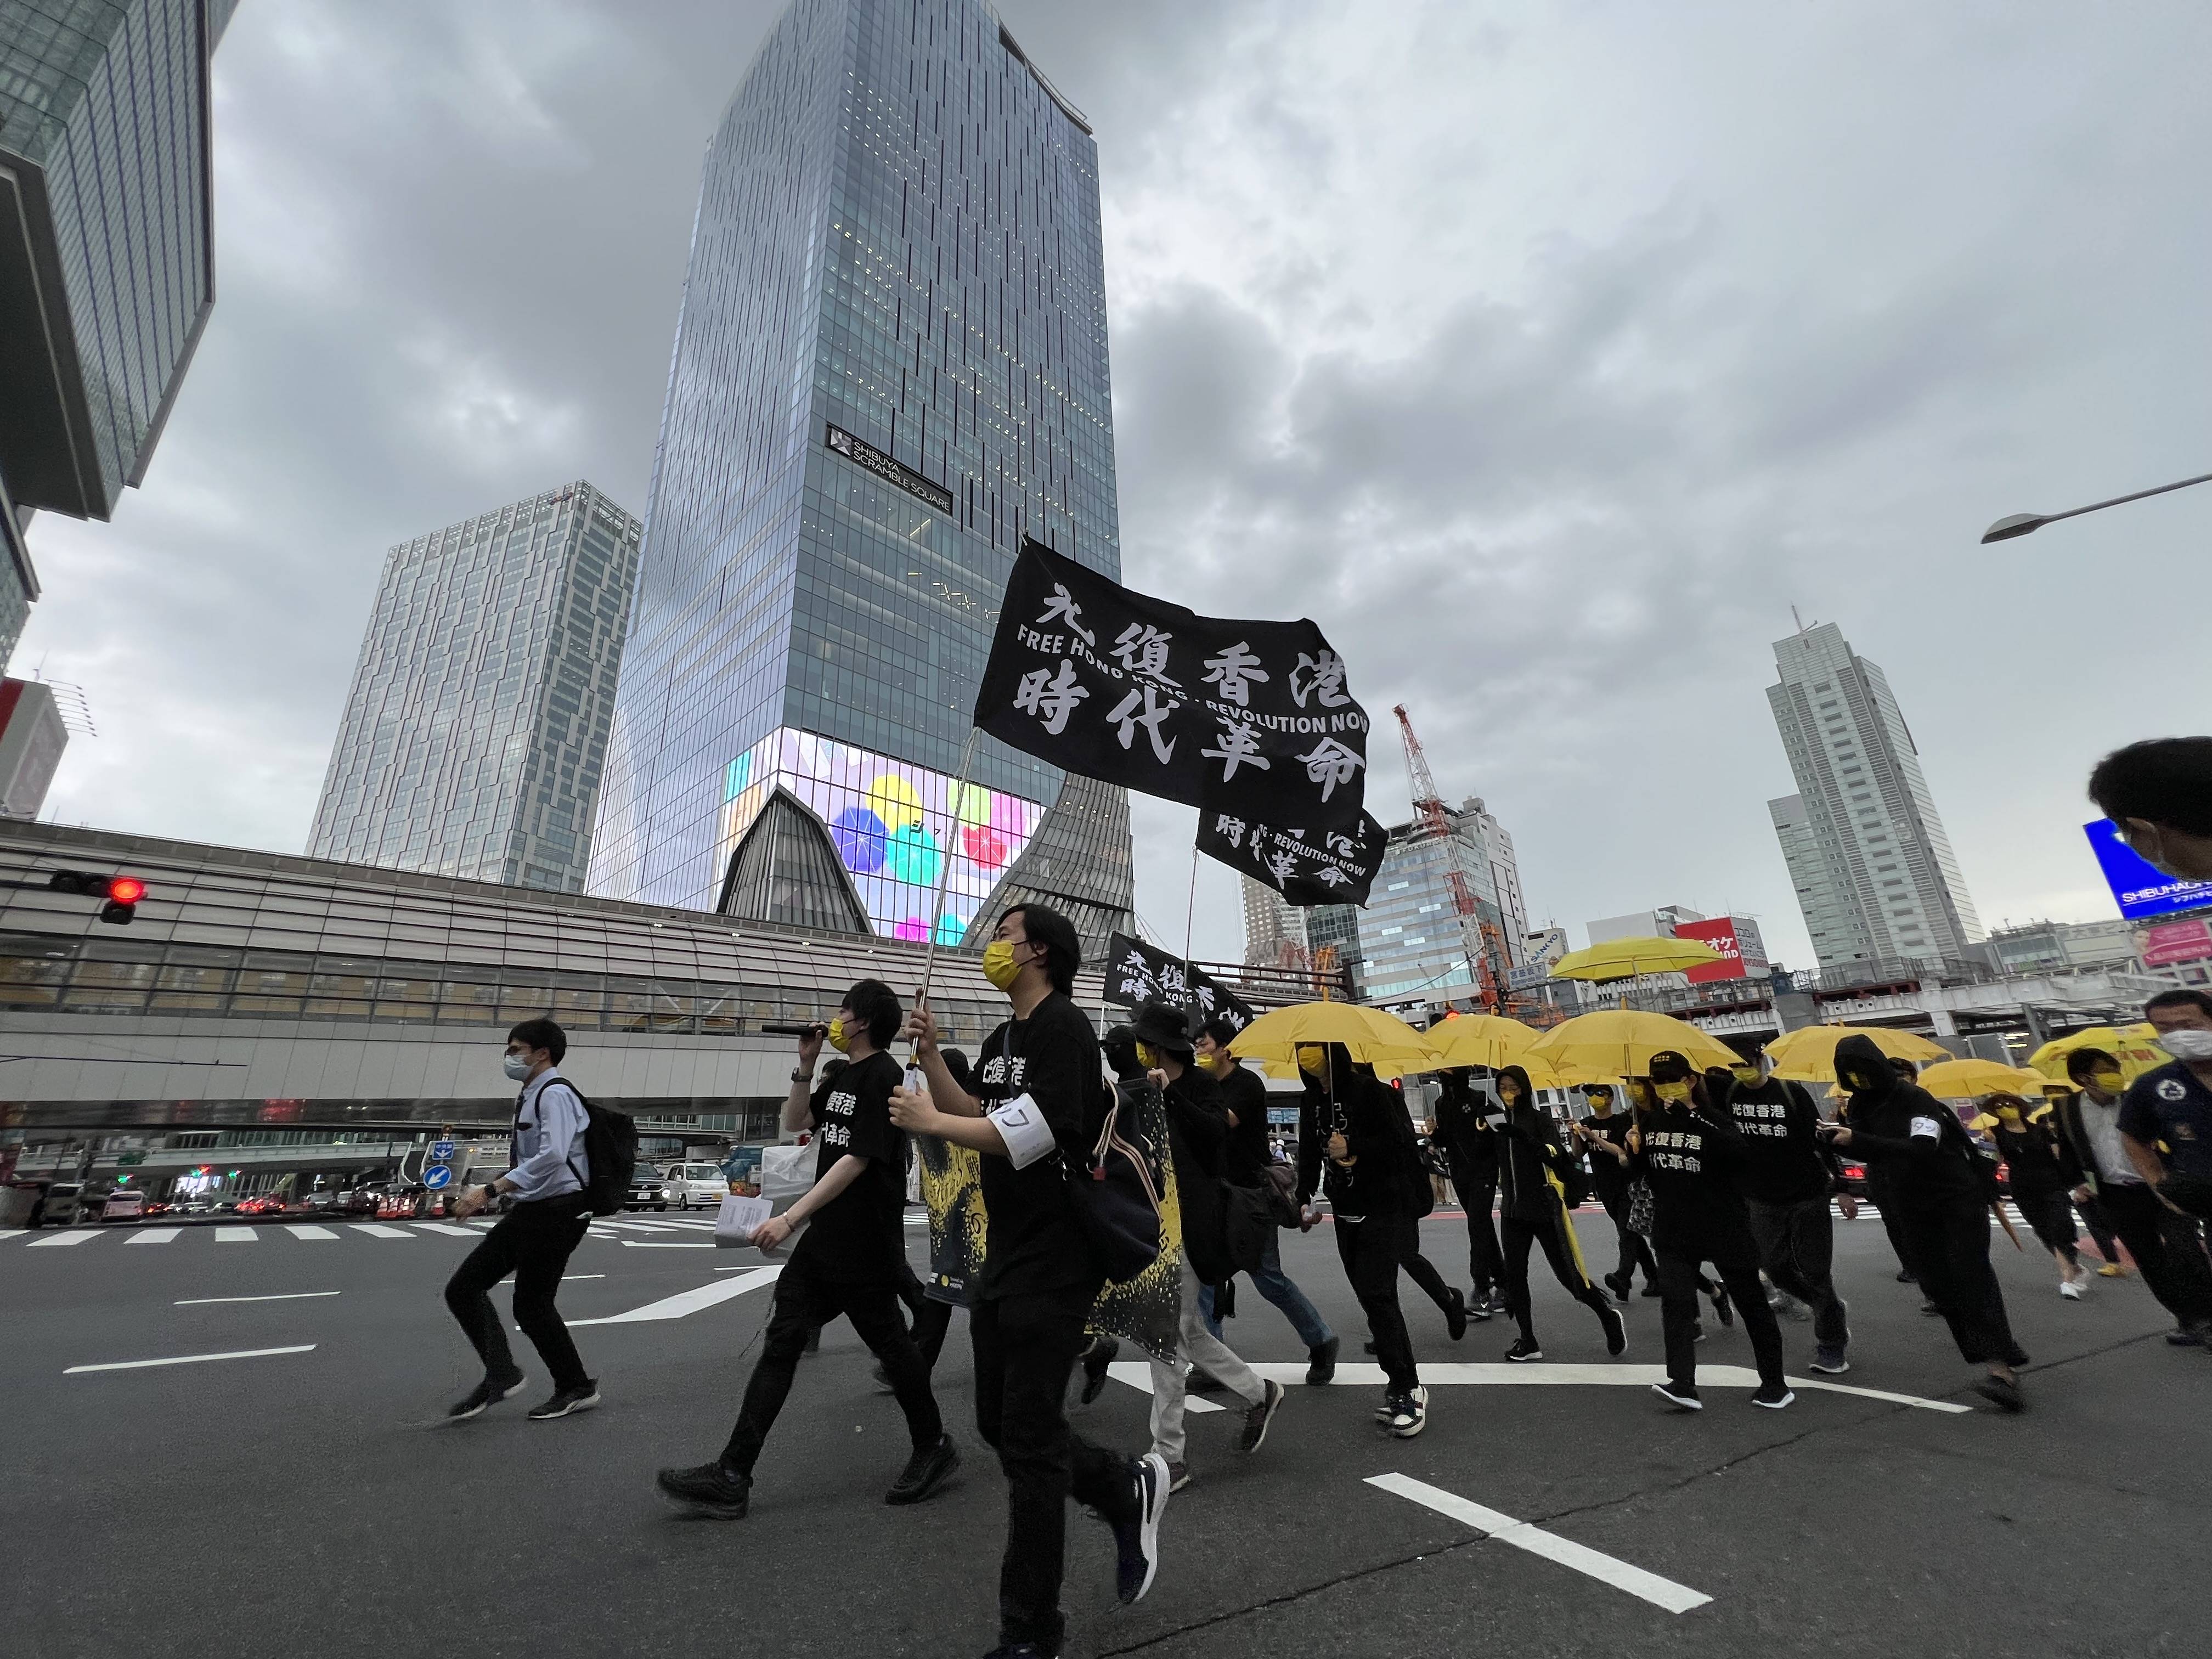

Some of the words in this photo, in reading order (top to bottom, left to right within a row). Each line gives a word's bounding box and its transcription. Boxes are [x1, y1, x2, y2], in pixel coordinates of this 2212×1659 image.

[854, 442, 900, 473] SHIBUYA
[853, 451, 909, 488] SCRAMBLE
[911, 483, 950, 511] SQUARE
[1017, 623, 1064, 654] FREE
[1070, 637, 1123, 679] HONG
[1131, 675, 1188, 700] KONG
[1206, 700, 1326, 733] REVOLUTION
[1013, 659, 1365, 803] 時代革命
[1274, 833, 1337, 865] REVOLUTION
[1339, 860, 1366, 877] NOW
[1116, 964, 1139, 977] FREE
[1166, 991, 1193, 1003] KONG
[1731, 1103, 1785, 1118] 光復香港
[1649, 1153, 1700, 1172] 代革命
